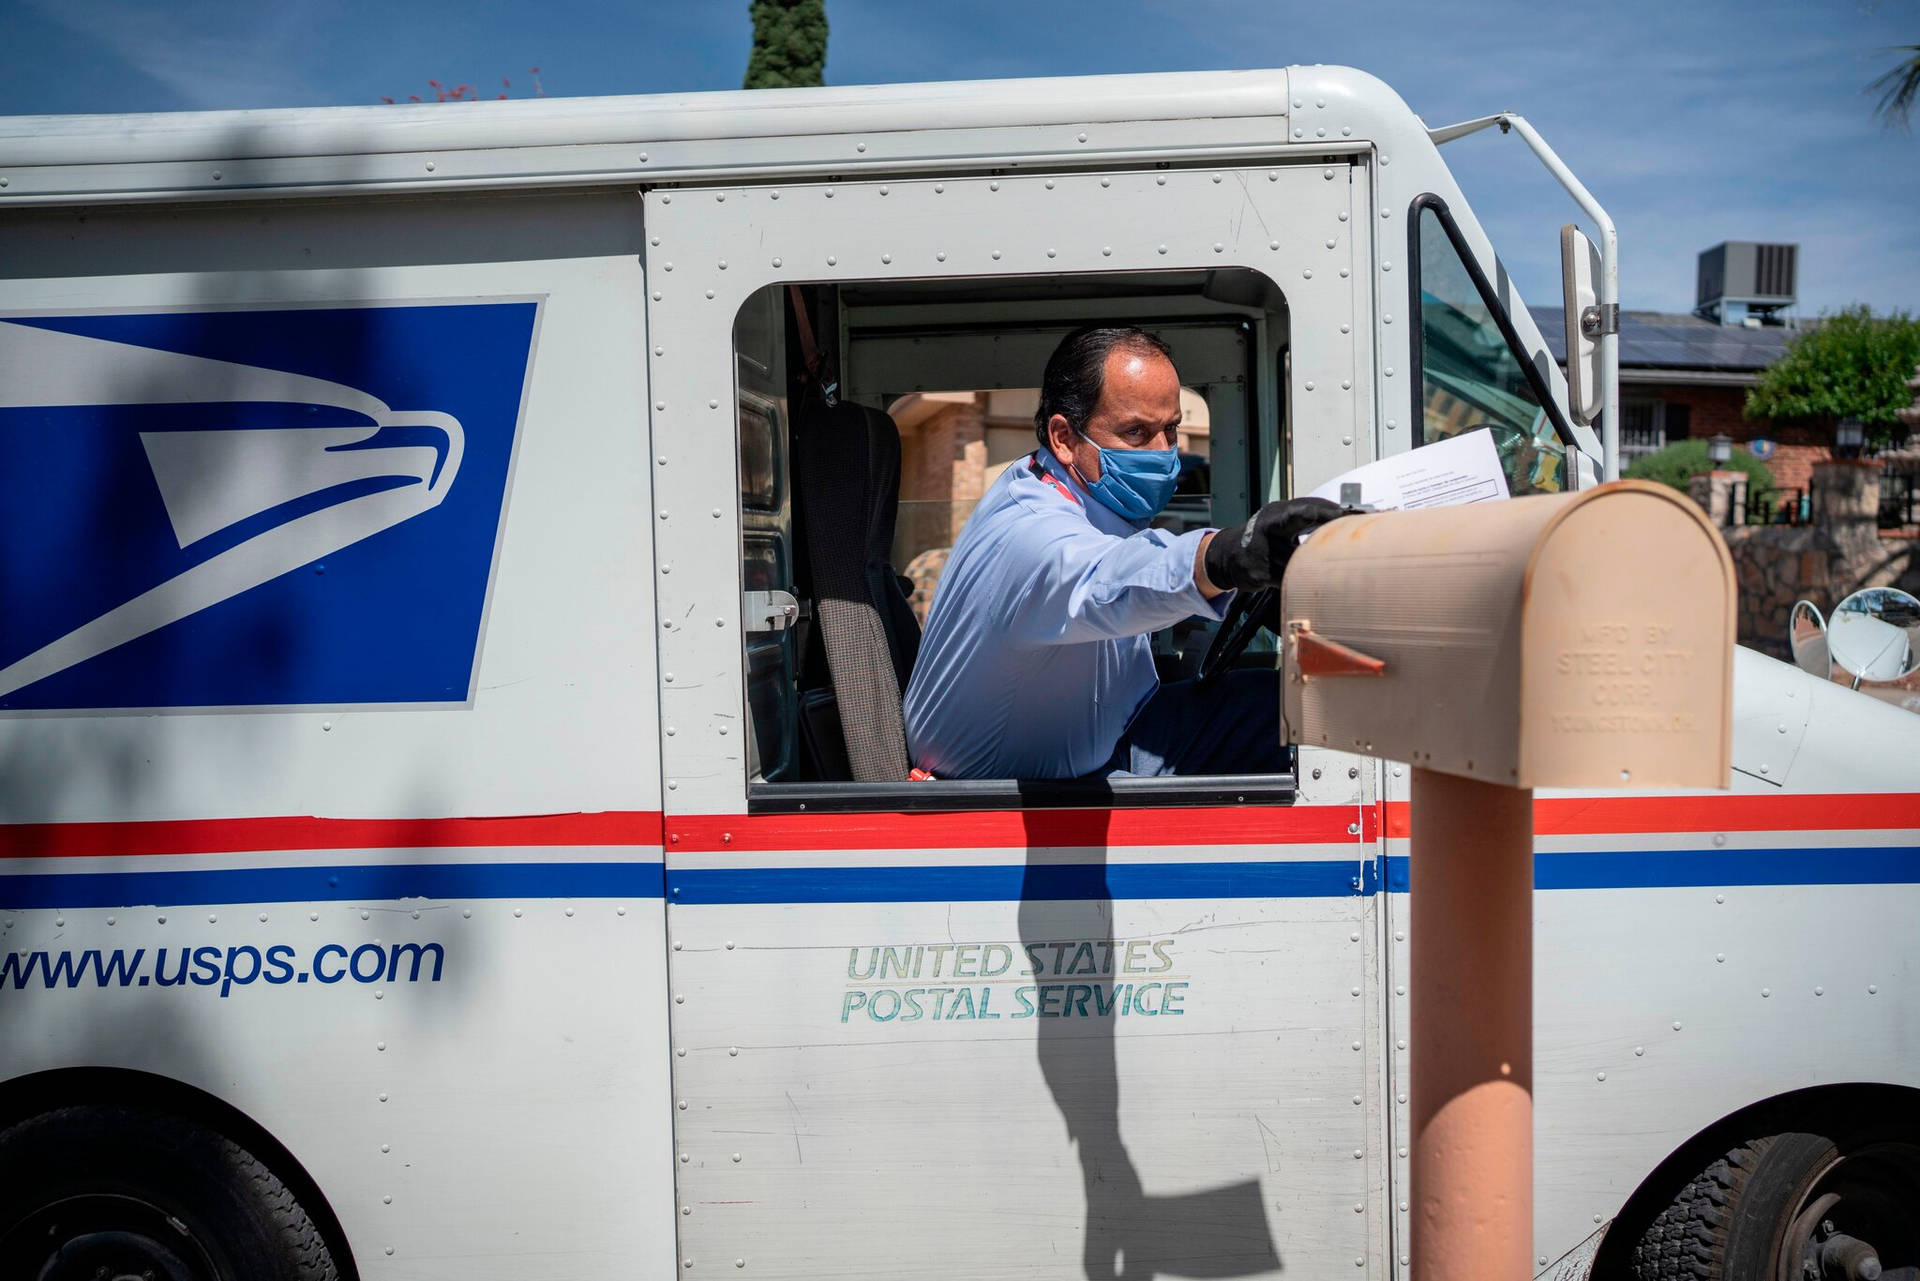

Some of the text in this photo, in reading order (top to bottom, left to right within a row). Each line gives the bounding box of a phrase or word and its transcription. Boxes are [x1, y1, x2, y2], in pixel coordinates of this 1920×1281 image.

[1642, 622, 1673, 645] BY
[1556, 648, 1696, 676] STEEL CITY
[0, 942, 446, 998] www.usps.com
[847, 939, 1175, 980] UNITED STATES
[839, 982, 1190, 1024] POSTAL SERVICE
